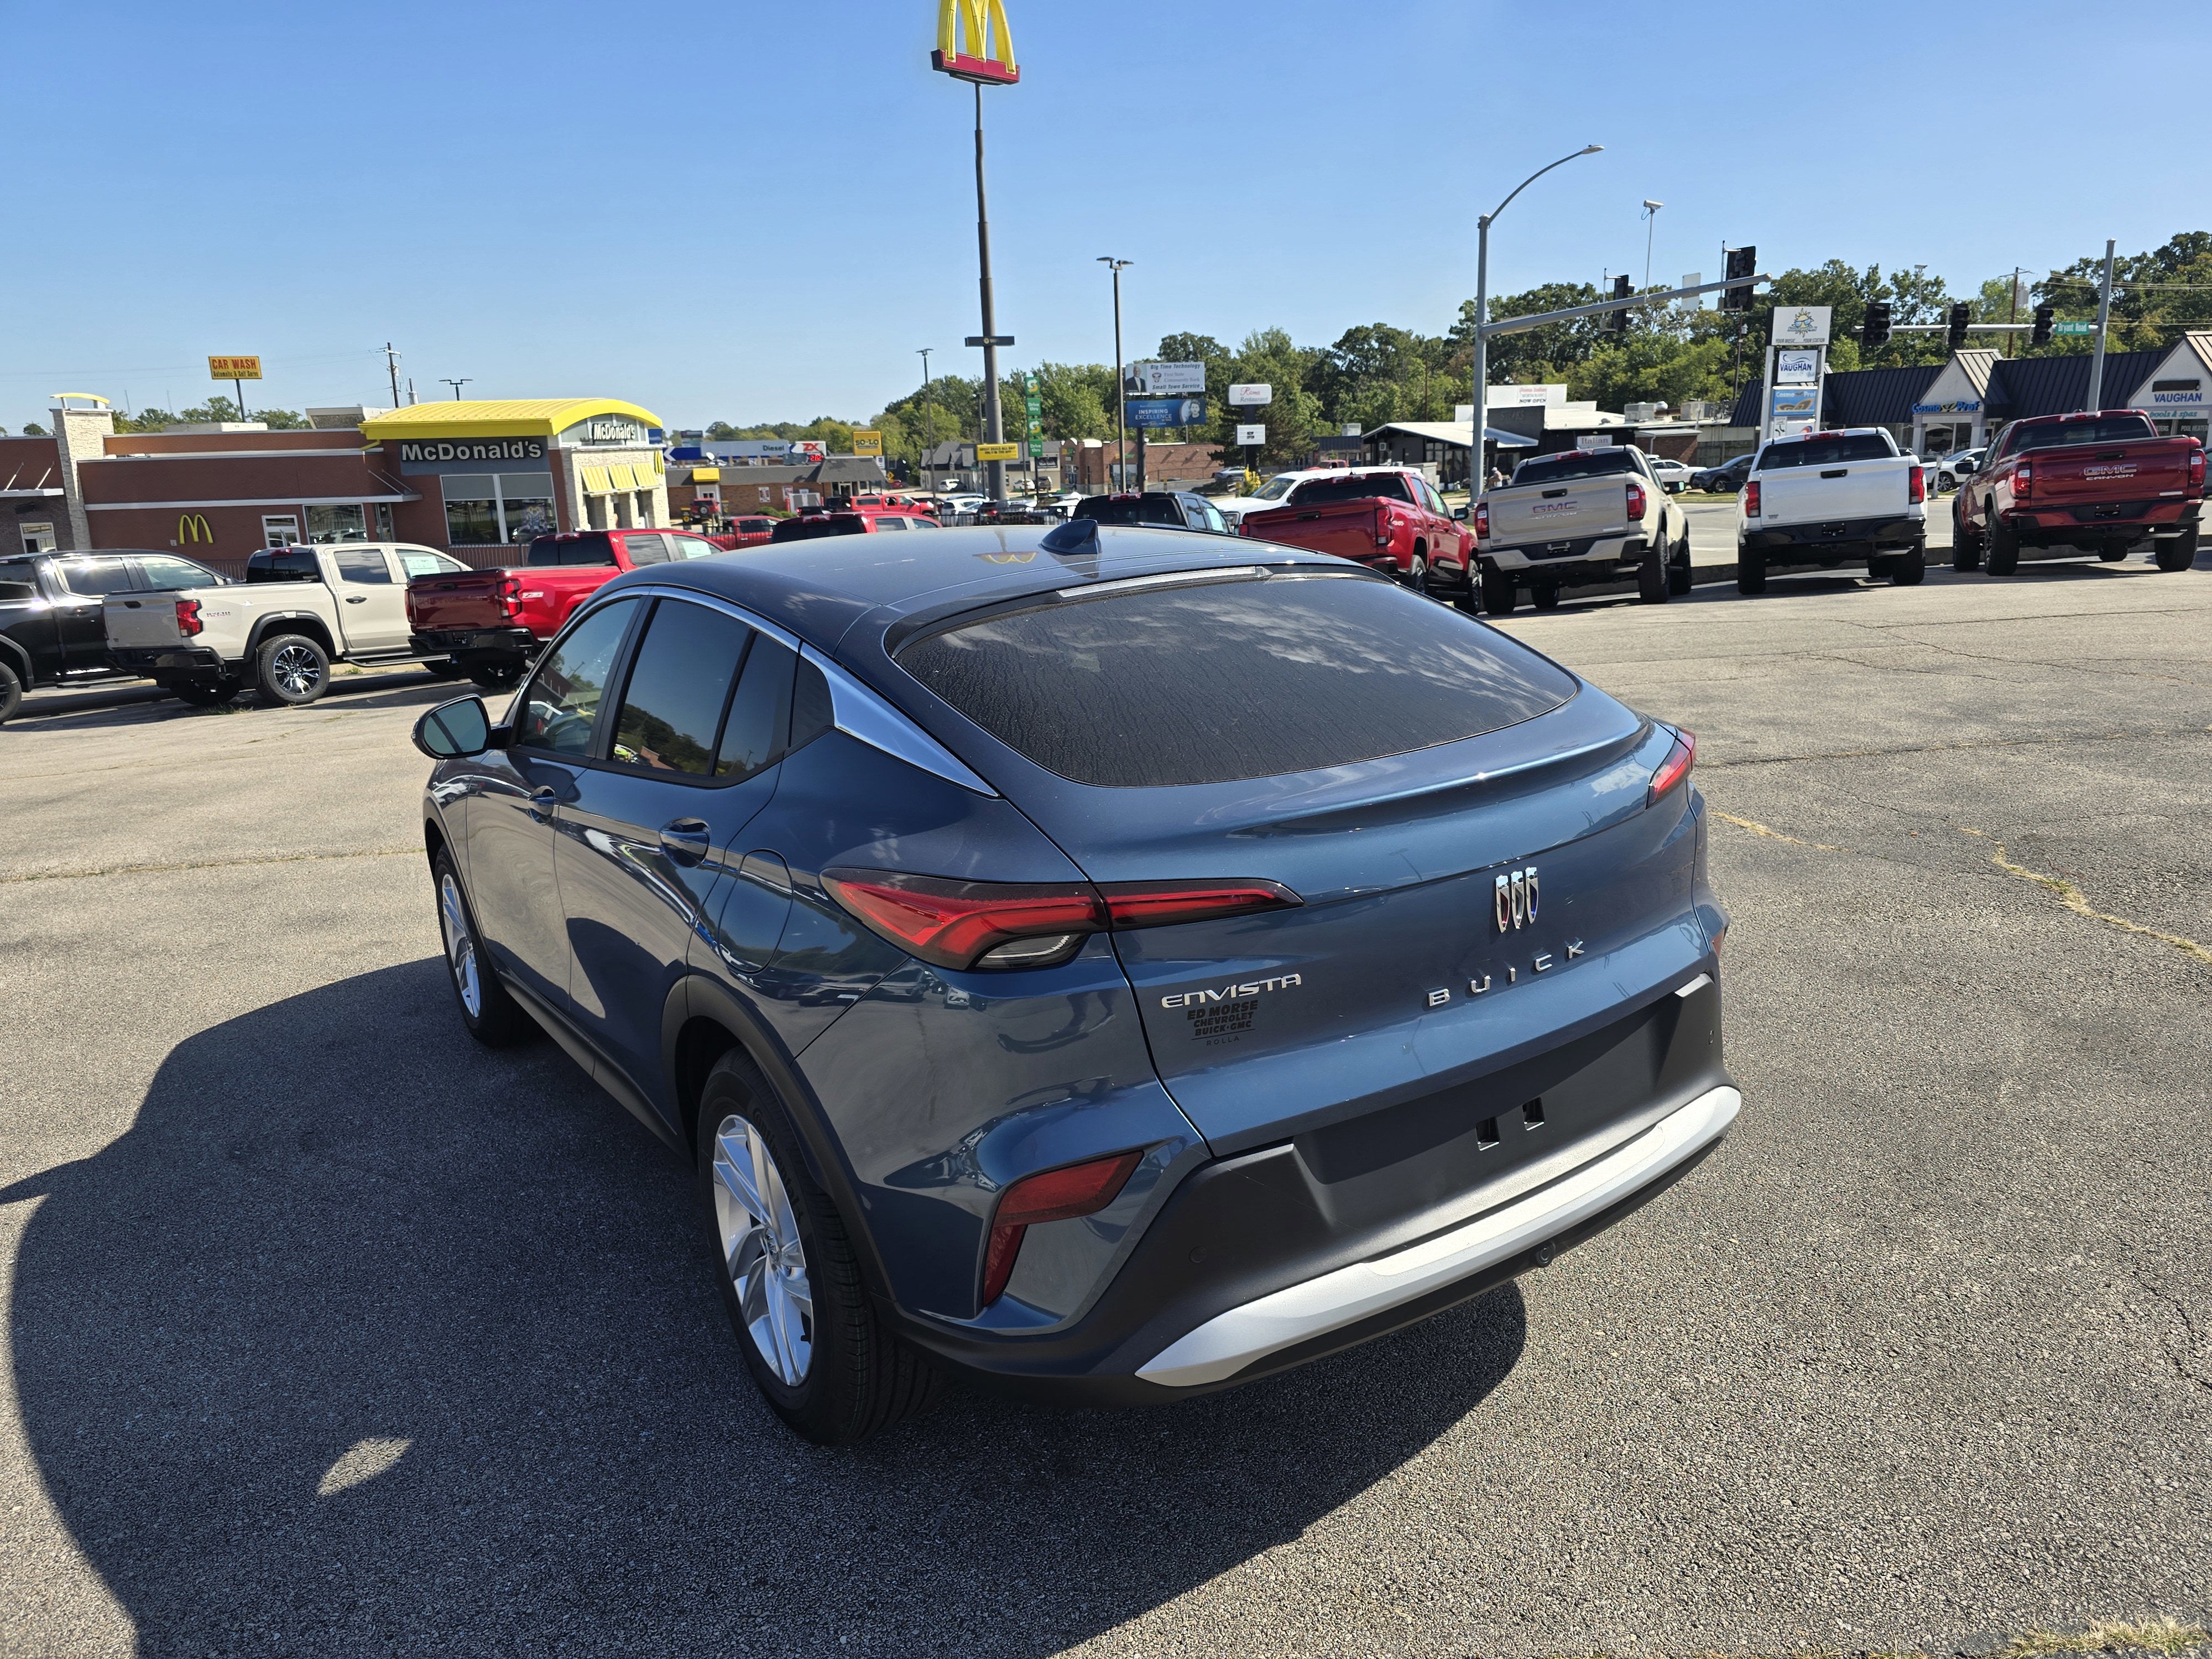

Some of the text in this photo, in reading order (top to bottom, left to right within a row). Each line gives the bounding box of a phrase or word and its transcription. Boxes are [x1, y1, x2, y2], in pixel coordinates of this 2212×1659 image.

[2058, 322, 2088, 334] Bryant Road
[212, 358, 257, 369] CAR WASH
[1780, 363, 1812, 372] VAUGHAN
[2154, 393, 2202, 403] VAUGHAN
[1912, 401, 1980, 413] Cosmo Prof
[593, 424, 635, 440] McDonald's
[402, 441, 541, 461] McDonald's
[2084, 464, 2137, 476] GMC
[1532, 501, 1578, 514] GMC
[1428, 940, 1585, 1007] BUICK
[1161, 973, 1301, 1008] ENVISTA
[1187, 1000, 1259, 1021] ED MORSE
[1193, 1011, 1255, 1028] CHEVROLET
[1206, 1036, 1240, 1046] ROLLA
